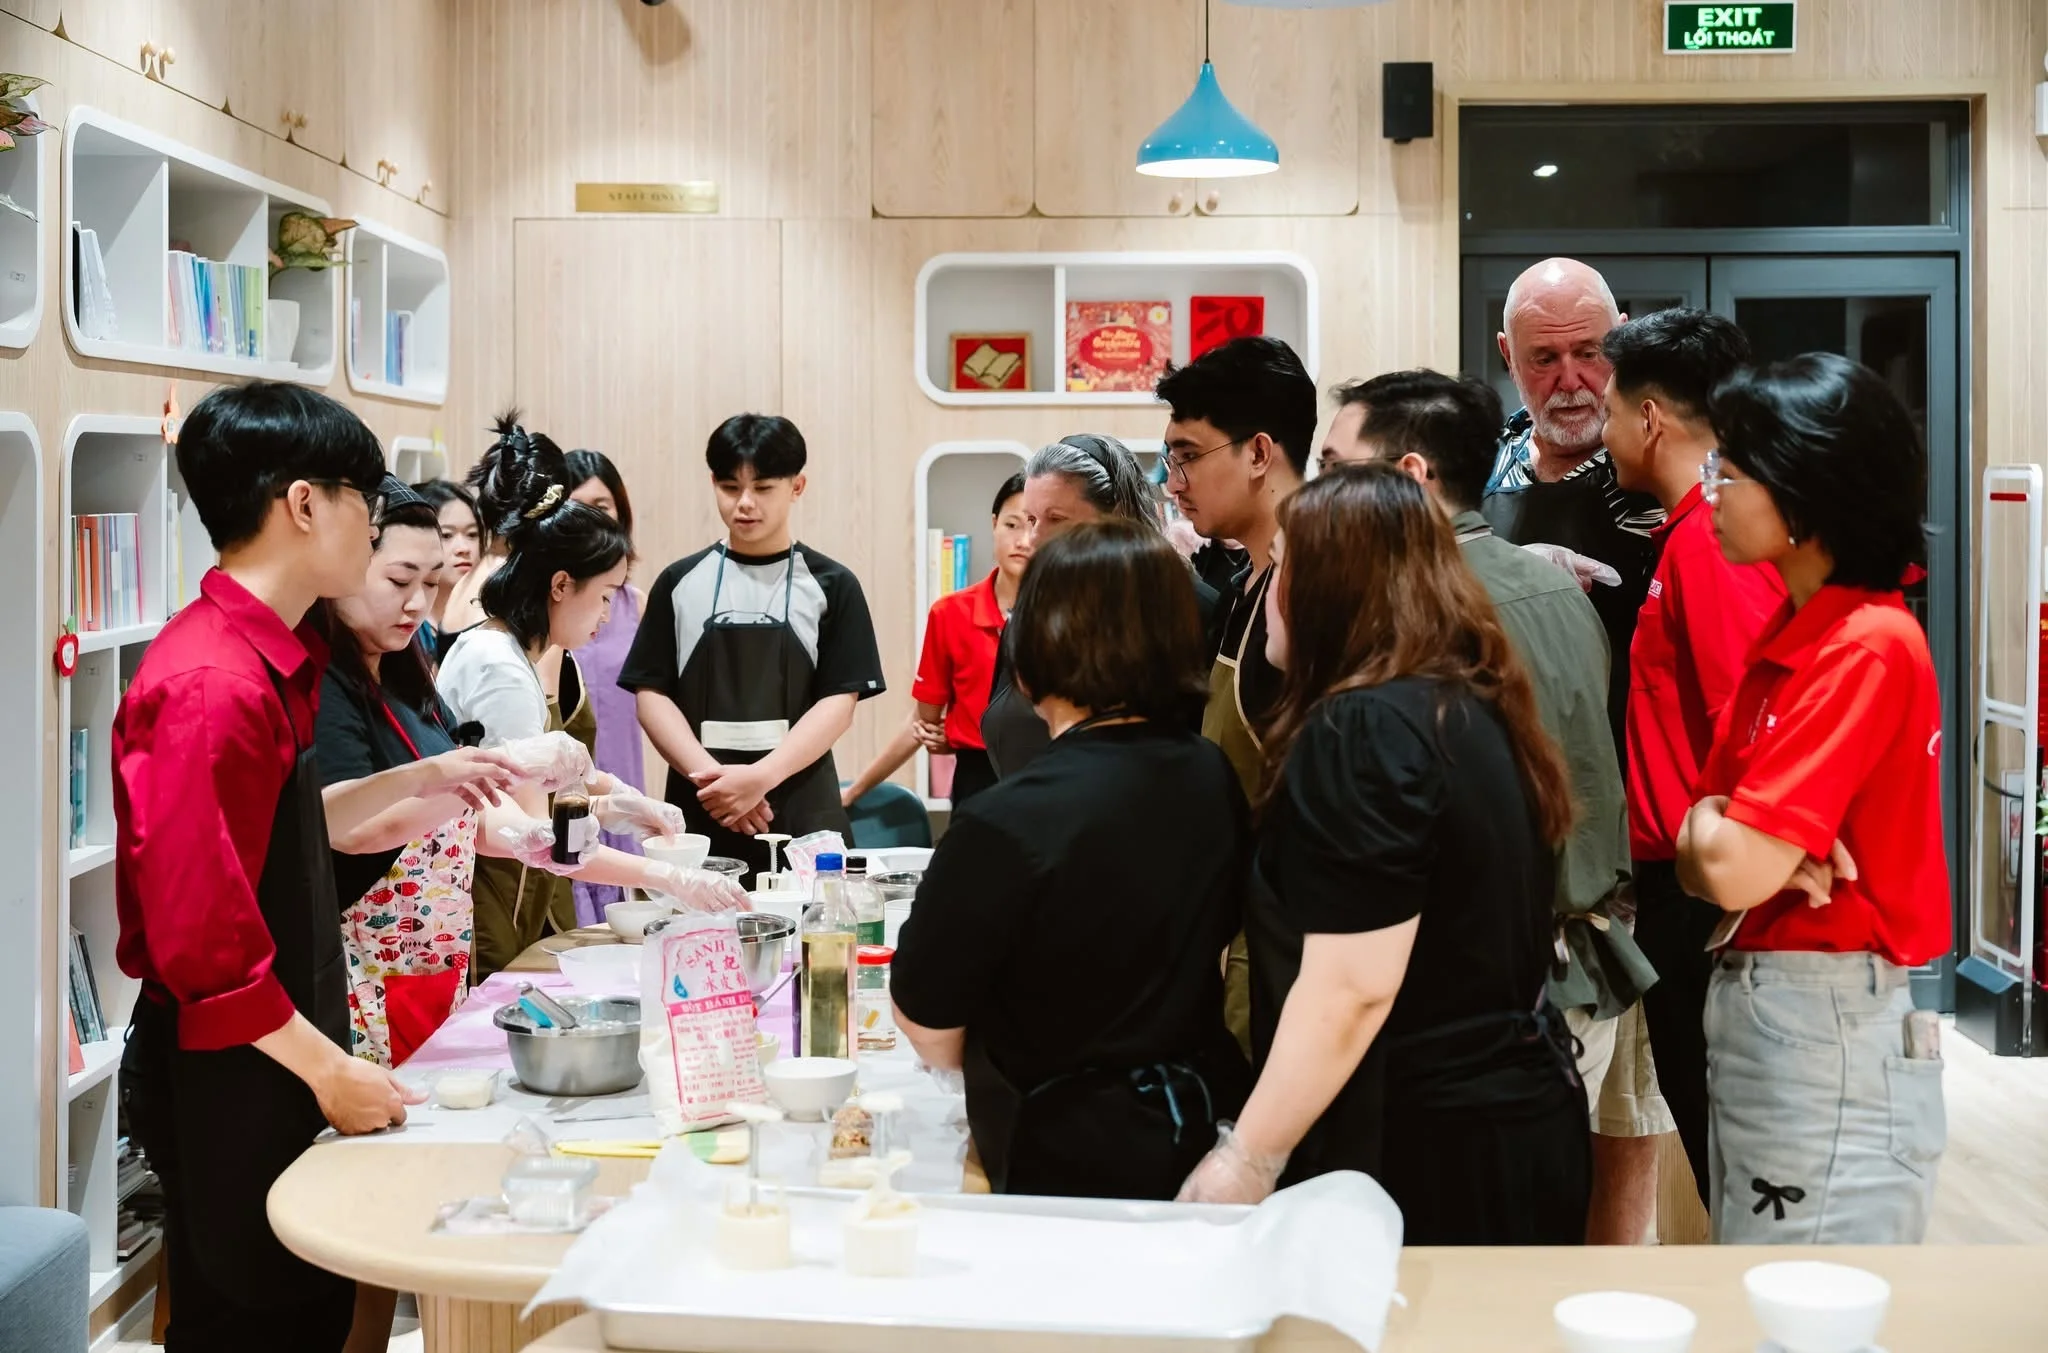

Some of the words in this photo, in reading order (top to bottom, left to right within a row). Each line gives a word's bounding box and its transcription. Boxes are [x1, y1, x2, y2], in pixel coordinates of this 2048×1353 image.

[1697, 7, 1762, 27] EXIT
[1715, 28, 1775, 46] THOÁT
[608, 192, 645, 201] STAFF
[650, 192, 685, 201] ONLY
